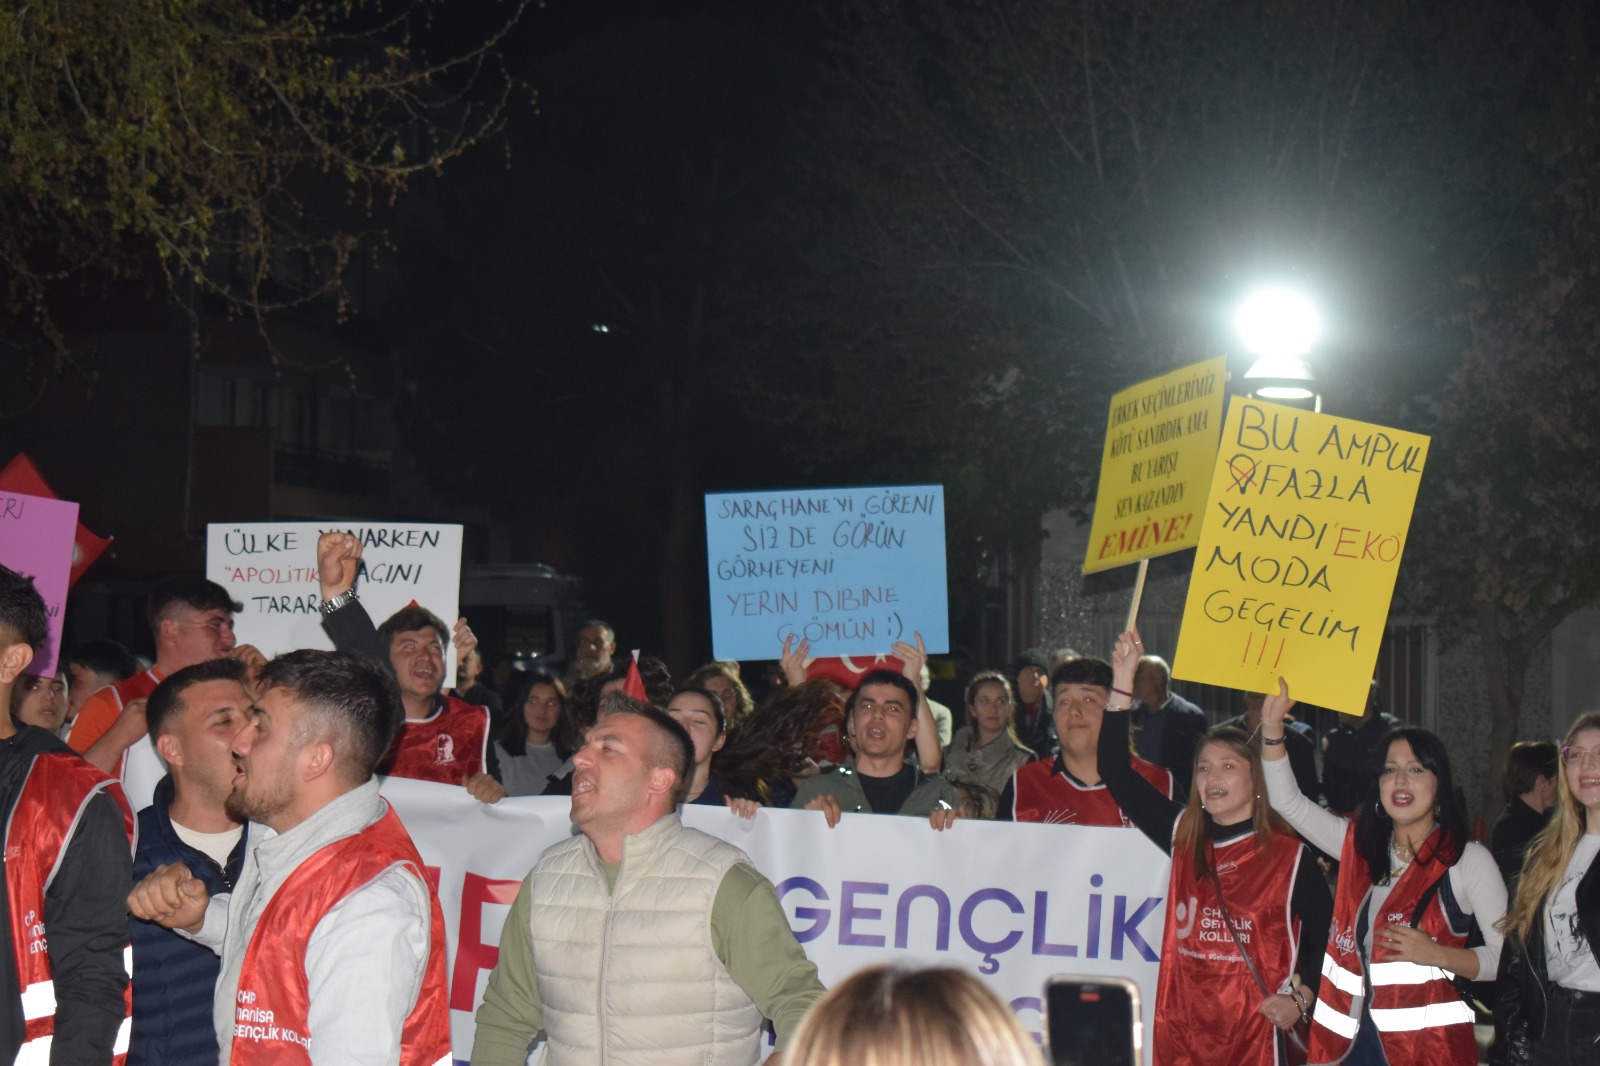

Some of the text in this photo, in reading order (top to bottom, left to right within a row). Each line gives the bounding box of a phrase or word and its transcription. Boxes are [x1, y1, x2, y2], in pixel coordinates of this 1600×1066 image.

[1111, 370, 1215, 429] ERKEK SEÇİMLERİMİZ
[1110, 408, 1209, 459] KÖTÜ SANIRDIK AMA
[1236, 404, 1421, 473] BU AMPUL
[1131, 451, 1179, 484] BU YARIŞI
[1258, 463, 1371, 505] FAZLA
[864, 489, 936, 516] GÖRENİ
[1114, 481, 1187, 520] SEN KAZANDIN
[224, 528, 298, 556] ÜLKE
[742, 513, 906, 551] SİZ DE GÖRÜN
[1098, 512, 1194, 560] EMİNE!
[1218, 502, 1328, 550] YANDI
[717, 552, 835, 581] GÖRMEYENİ
[1205, 545, 1332, 593] MODA
[777, 616, 875, 646] GÖMÜN
[1240, 631, 1285, 674] !!!
[774, 873, 1163, 975] GENÇLİK
[1388, 913, 1403, 921] CHP
[237, 990, 256, 1004] CHP
